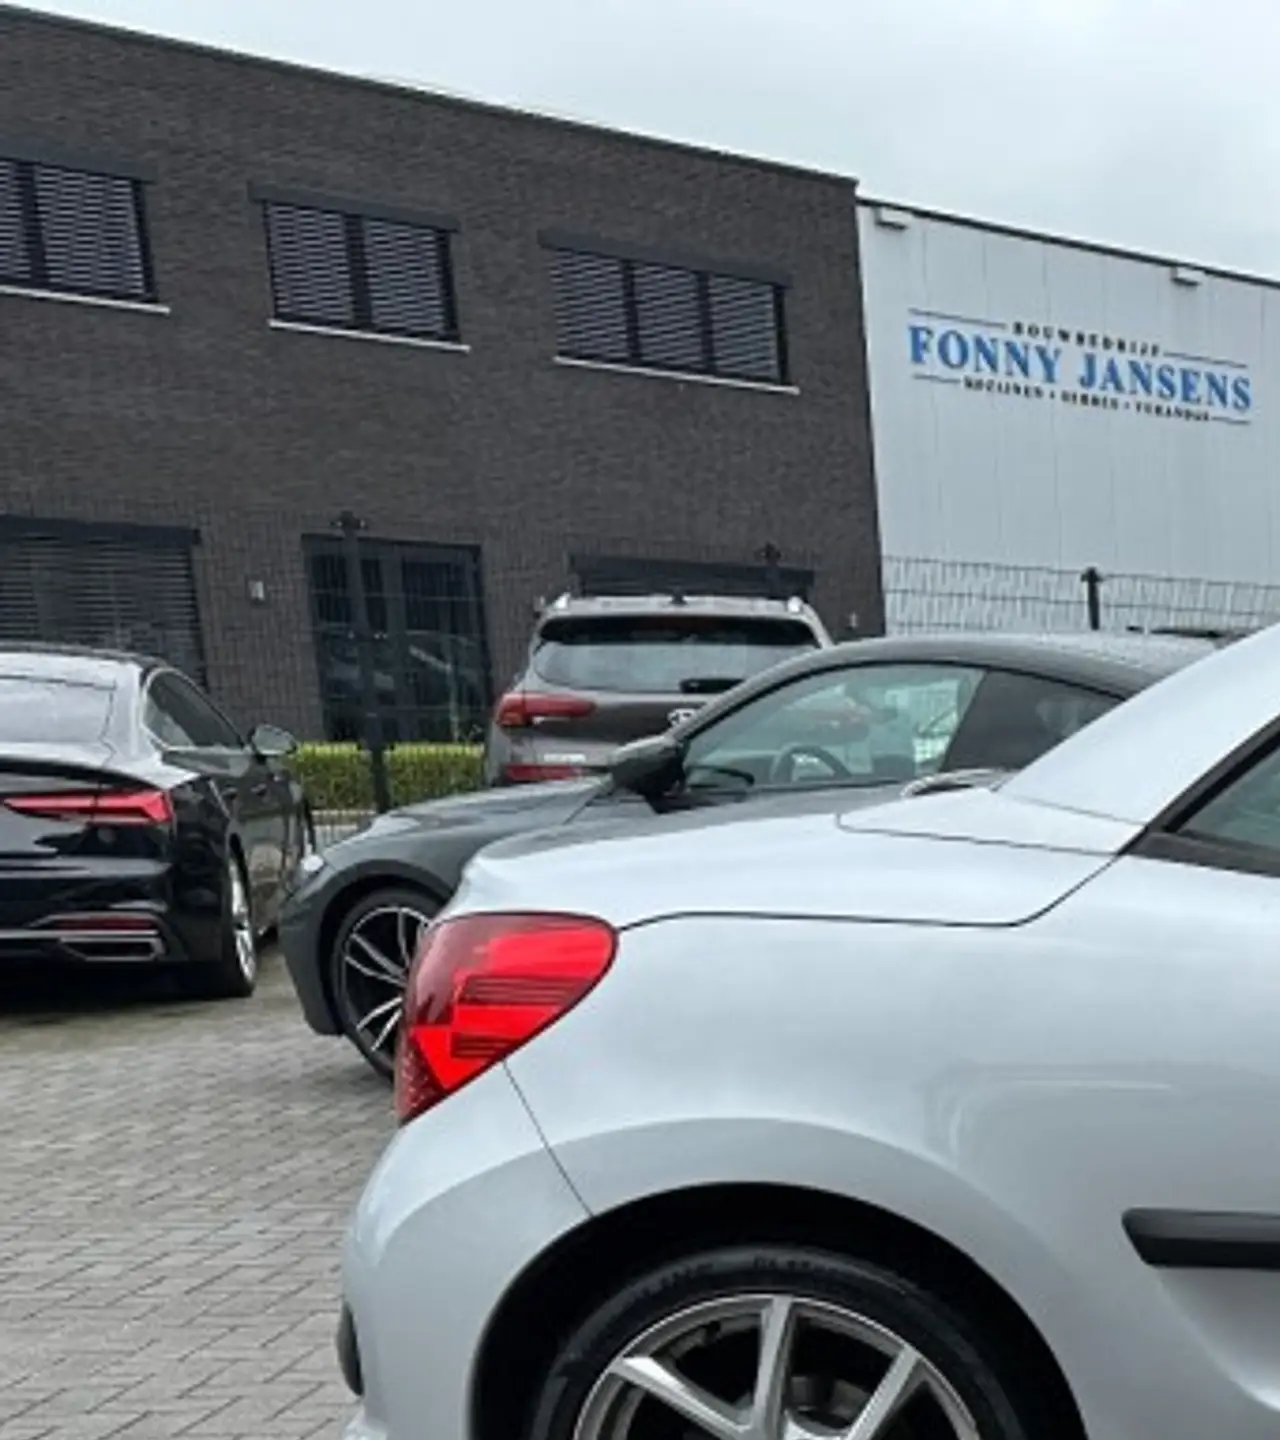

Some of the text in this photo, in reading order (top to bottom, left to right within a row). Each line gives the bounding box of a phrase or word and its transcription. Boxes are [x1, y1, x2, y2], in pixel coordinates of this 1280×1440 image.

[907, 325, 1252, 412] FONNY JANSENS
[1012, 321, 1161, 357] BOUWBEDRIJF
